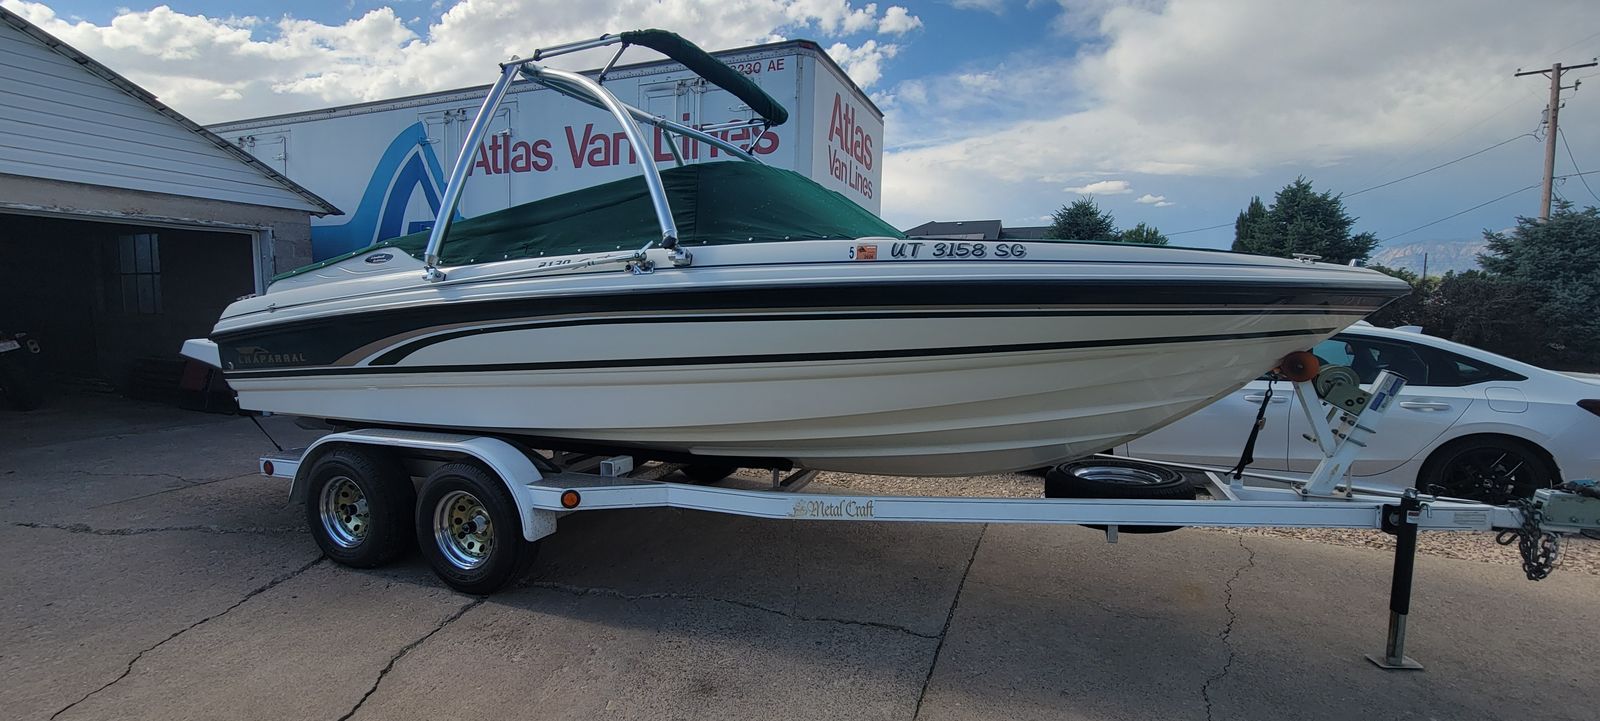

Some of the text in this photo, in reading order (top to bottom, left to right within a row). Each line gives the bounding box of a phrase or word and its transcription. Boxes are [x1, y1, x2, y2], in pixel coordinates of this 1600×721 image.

[767, 59, 784, 72] AE
[467, 112, 780, 177] Atlas Van Lines
[828, 92, 873, 171] Atlas
[828, 144, 873, 200] Van Lines
[849, 242, 1027, 259] 5 UT 3158 SG
[807, 500, 874, 517] Metal Craft
